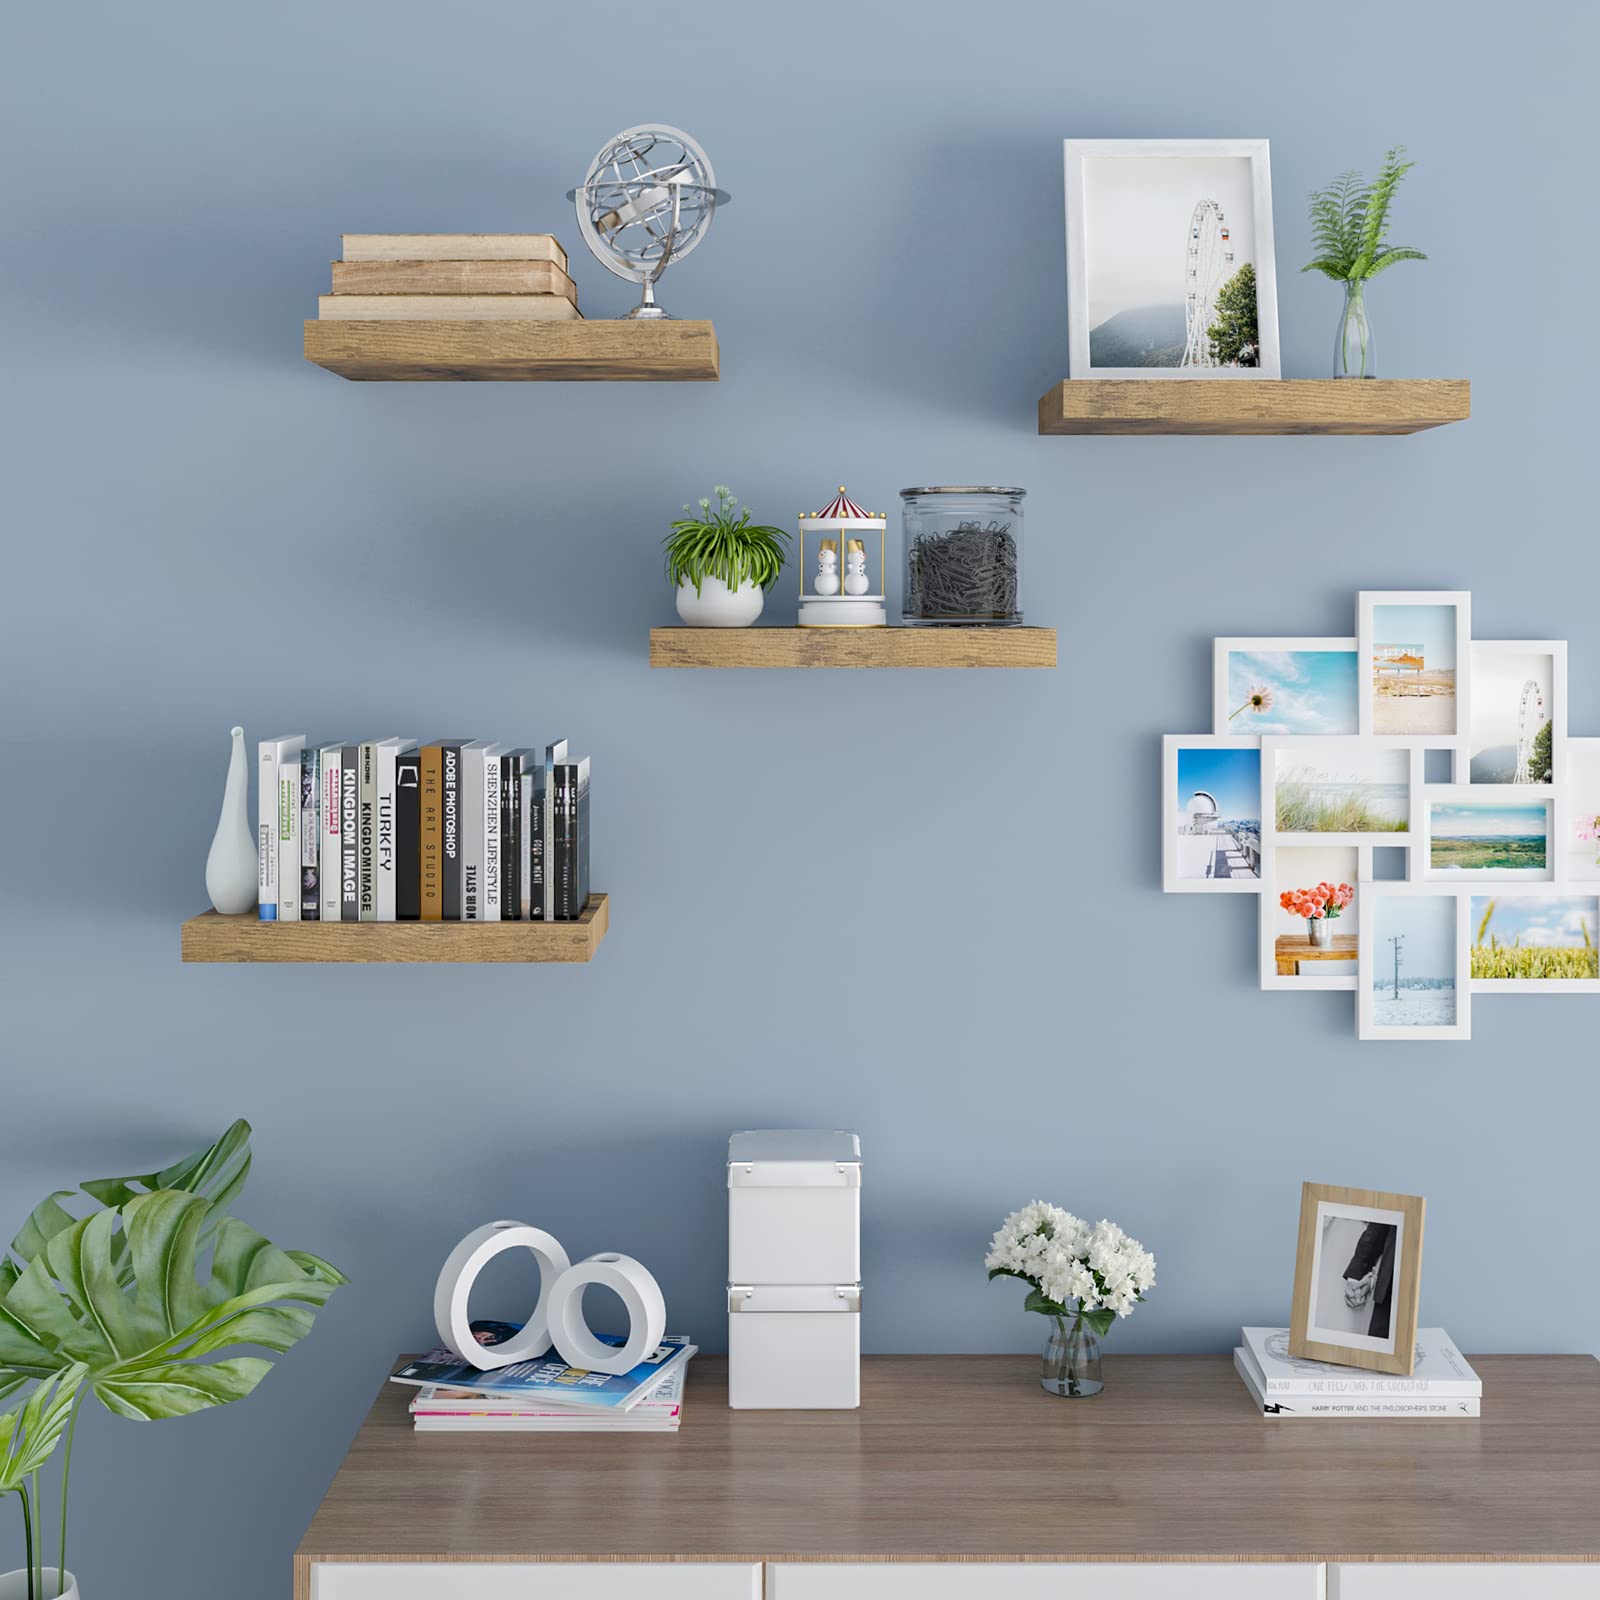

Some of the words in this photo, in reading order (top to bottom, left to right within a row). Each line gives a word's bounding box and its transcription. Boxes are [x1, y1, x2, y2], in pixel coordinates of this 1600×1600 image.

[425, 769, 436, 794] THE
[445, 750, 456, 789] ADOBE
[343, 768, 356, 845] KINGDOM
[487, 763, 498, 834] SHENZHEN
[379, 793, 392, 871] TURKFY
[425, 807, 436, 833] ART
[445, 790, 456, 859] PHOTOSHOP
[343, 850, 356, 902] IMAGE
[362, 802, 372, 912] KINGDOMIMAGE
[425, 844, 436, 898] STUDIO
[487, 838, 498, 905] LIFESTYLE
[466, 864, 477, 893] STYLE
[466, 895, 477, 919] NOIR
[525, 1362, 570, 1385] OFFICE
[553, 1367, 590, 1386] NEW
[578, 1373, 613, 1387] THE
[1428, 1404, 1448, 1412] STONE
